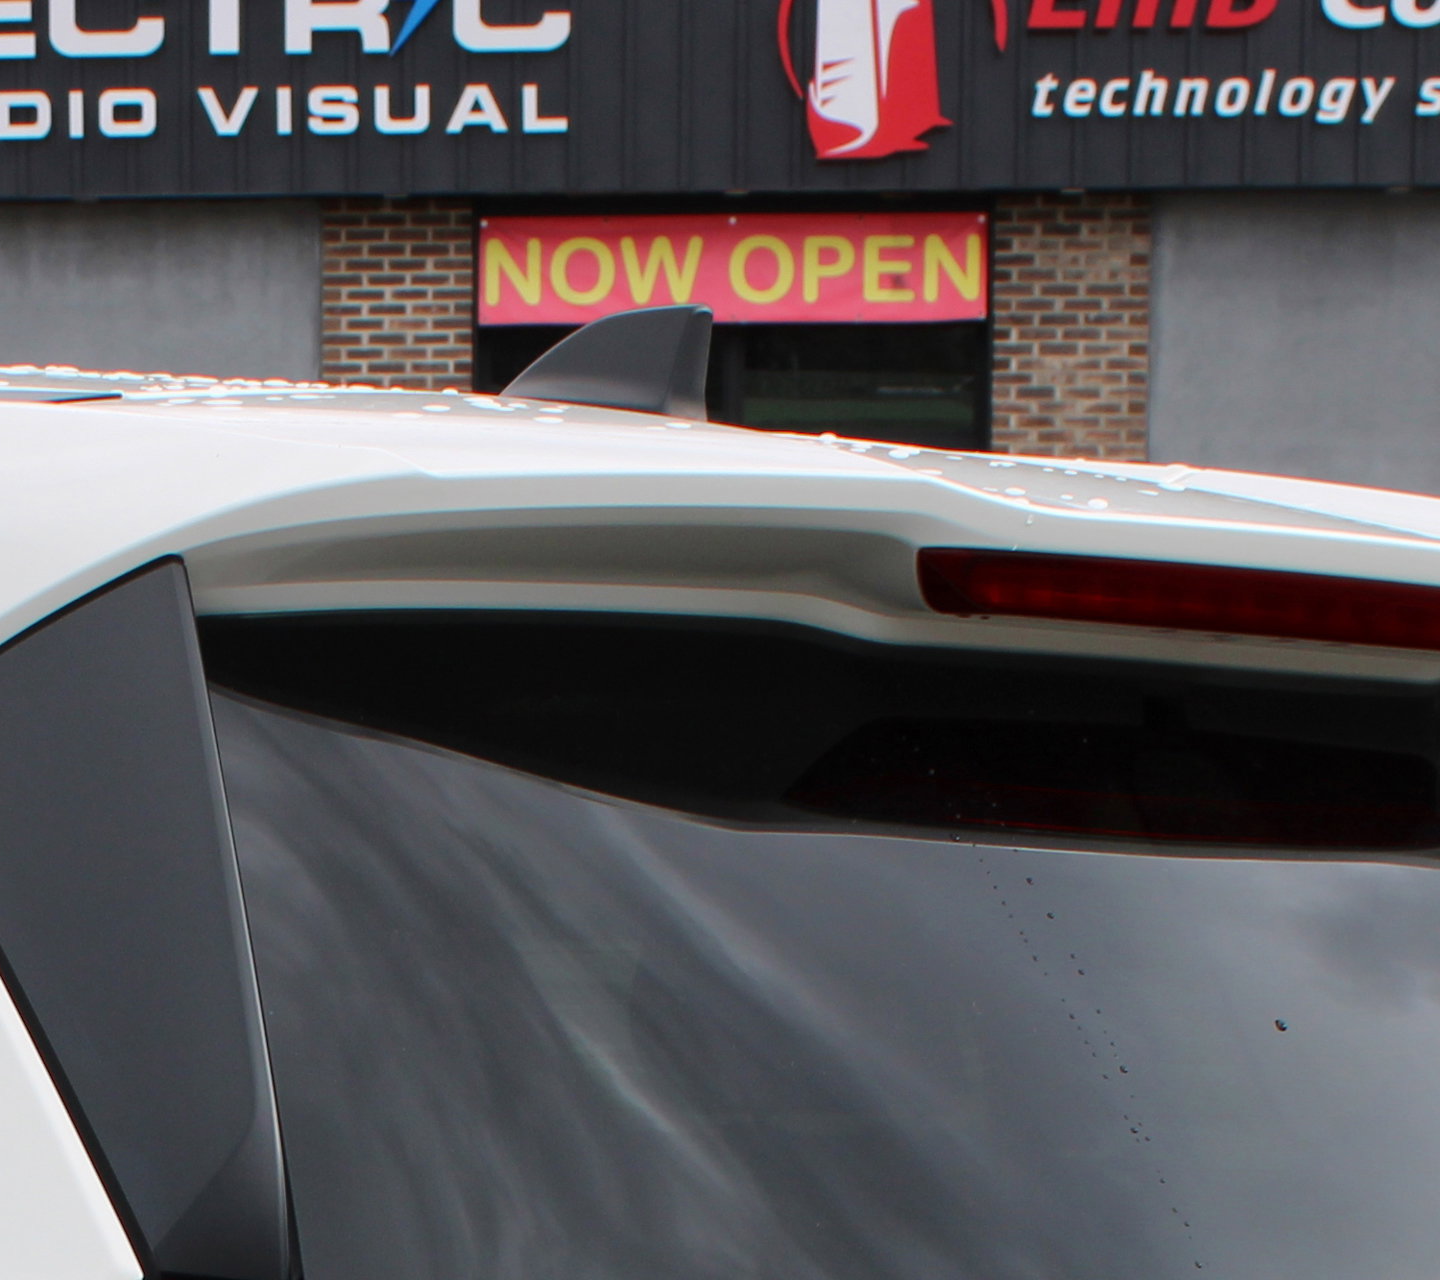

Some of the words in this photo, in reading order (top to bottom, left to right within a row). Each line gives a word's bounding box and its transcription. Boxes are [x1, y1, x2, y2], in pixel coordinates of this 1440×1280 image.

[197, 83, 569, 137] VISUAL
[1031, 68, 1395, 123] technology
[484, 235, 704, 305] NOW
[728, 233, 982, 303] OPEN
